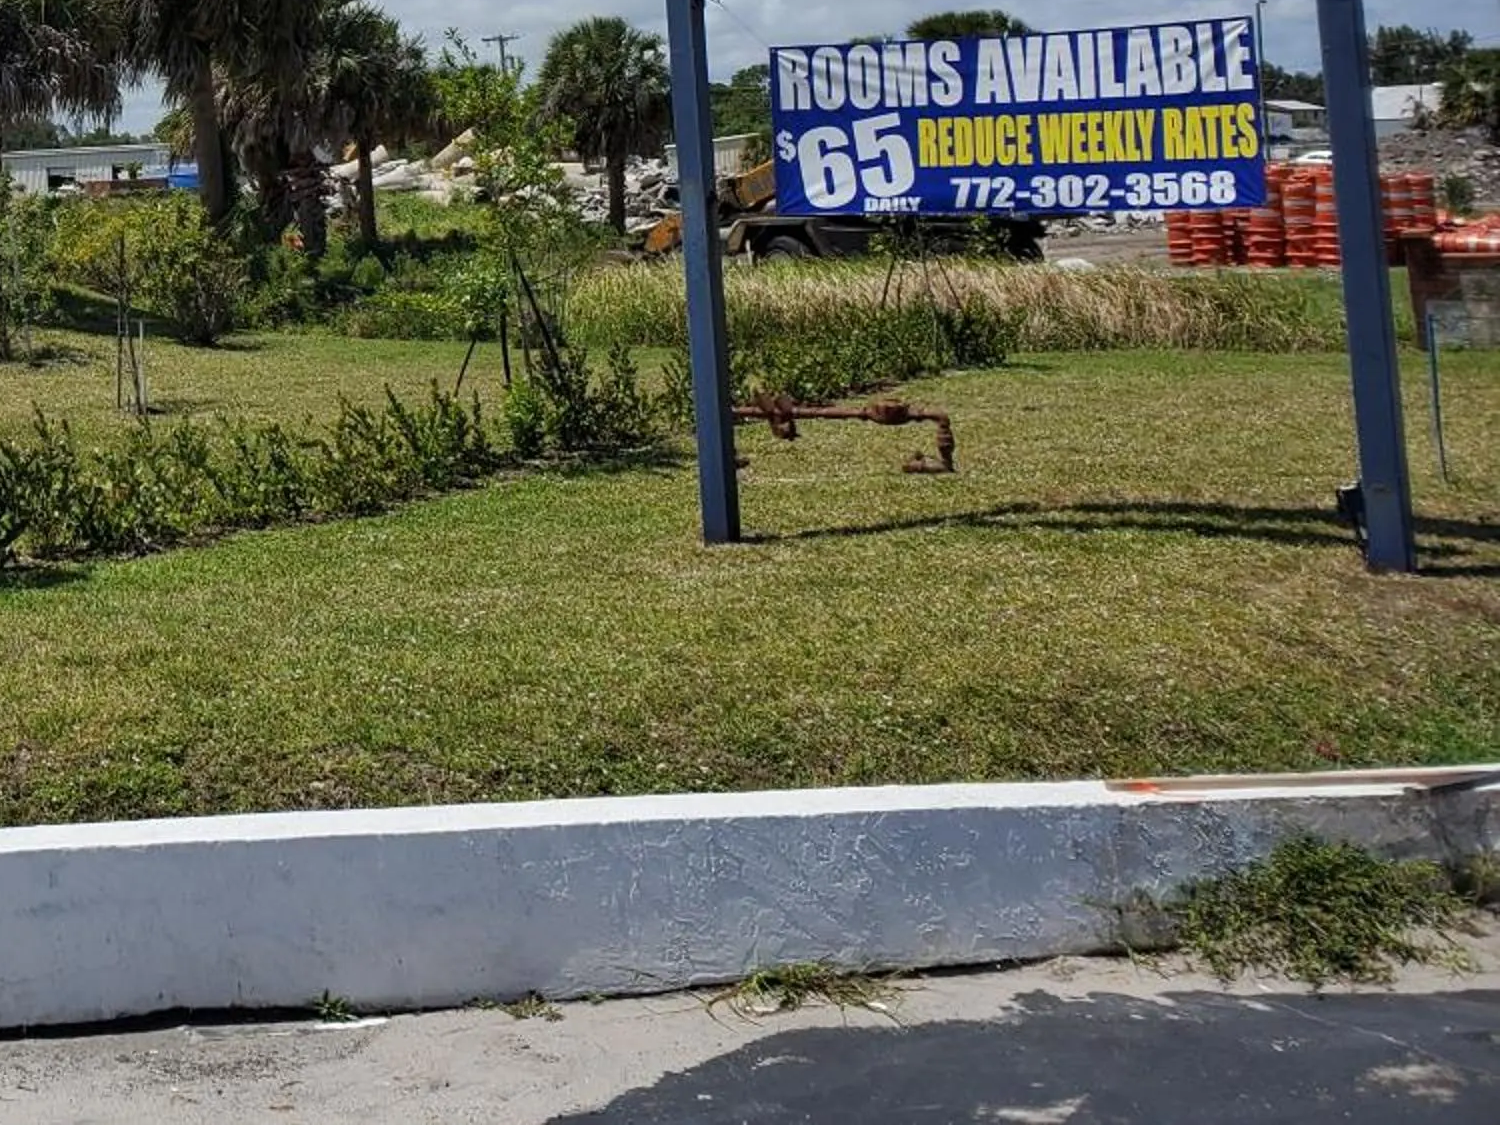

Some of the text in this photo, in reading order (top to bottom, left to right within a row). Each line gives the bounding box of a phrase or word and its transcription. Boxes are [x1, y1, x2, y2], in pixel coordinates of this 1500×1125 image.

[778, 18, 1253, 111] ROOMS AVAILABLE
[777, 113, 915, 209] $65
[918, 102, 1258, 167] REDUCE WEEKLY RATES
[863, 196, 922, 212] DAILY
[951, 171, 1236, 209] 772-302-3568
